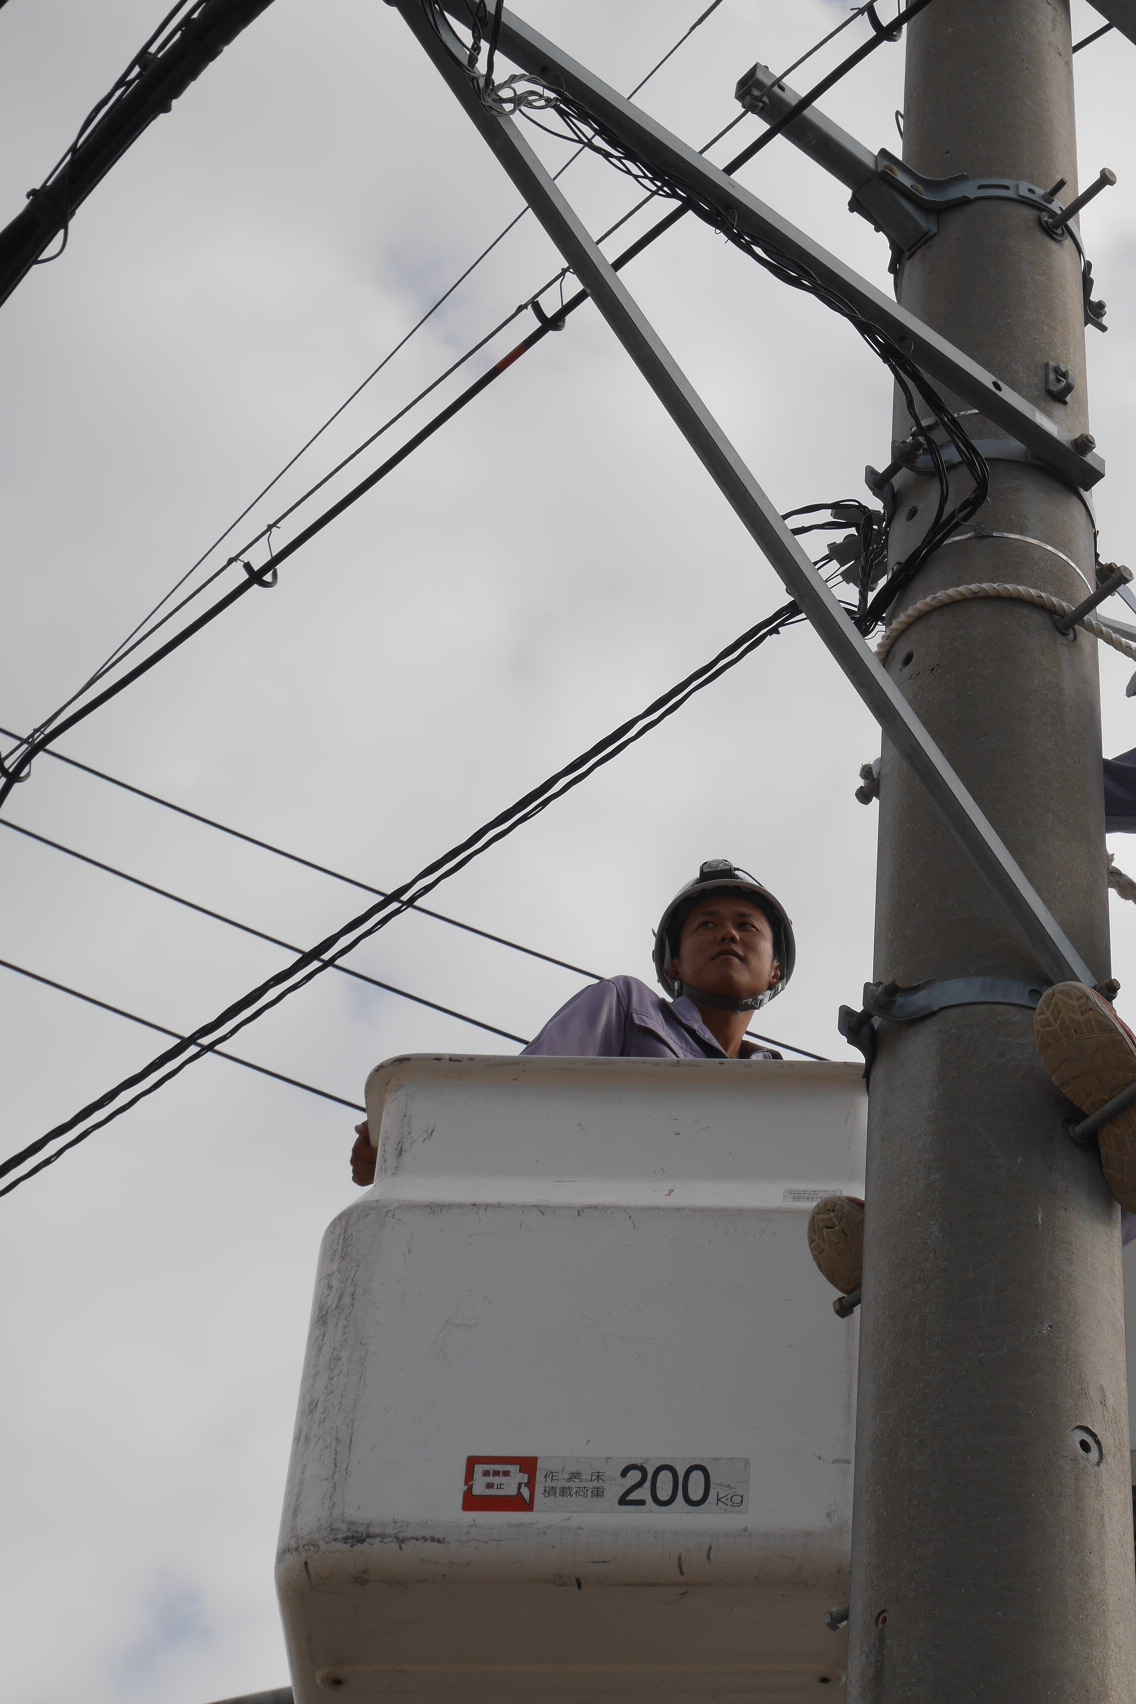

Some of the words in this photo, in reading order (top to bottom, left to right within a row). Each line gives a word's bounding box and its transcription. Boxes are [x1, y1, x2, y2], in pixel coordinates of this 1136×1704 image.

[543, 1470, 606, 1483] 作業床
[542, 1485, 606, 1498] 積載荷重
[617, 1463, 711, 1507] 200
[716, 1491, 744, 1507] kg
